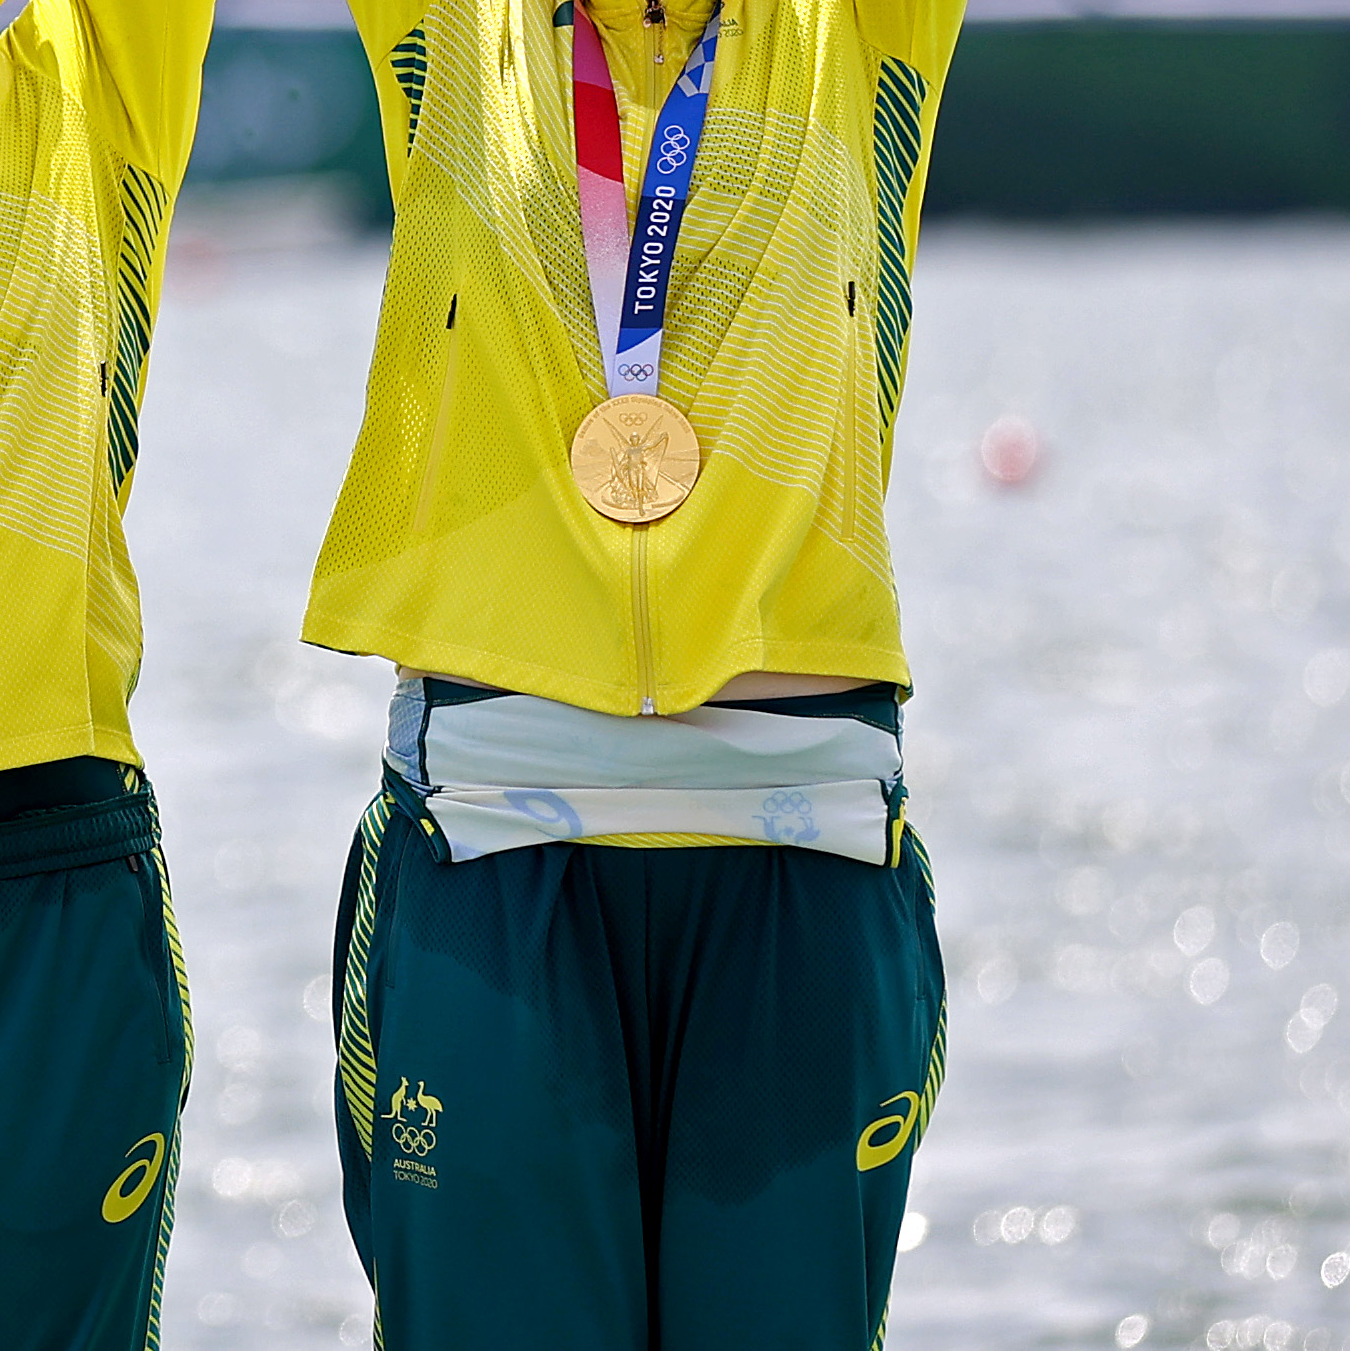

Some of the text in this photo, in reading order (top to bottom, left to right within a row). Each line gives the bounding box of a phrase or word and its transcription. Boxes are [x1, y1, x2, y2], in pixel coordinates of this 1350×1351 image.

[633, 185, 676, 315] TOKYO 2020
[393, 1158, 436, 1177] AUSTRALIA
[393, 1169, 438, 1189] TOKYO 2020
